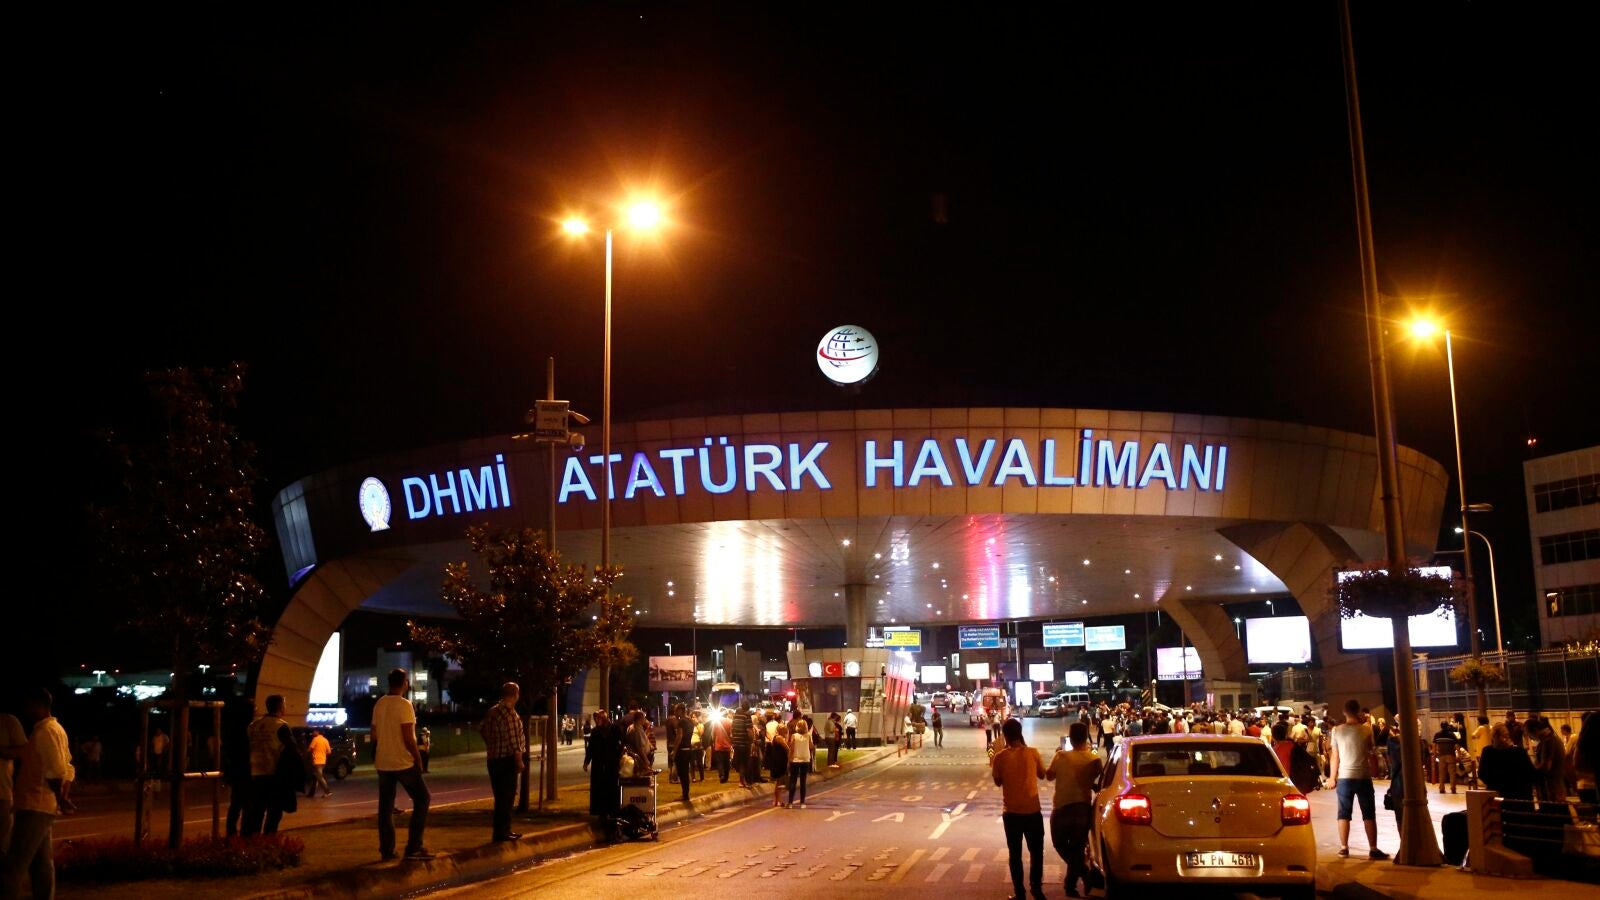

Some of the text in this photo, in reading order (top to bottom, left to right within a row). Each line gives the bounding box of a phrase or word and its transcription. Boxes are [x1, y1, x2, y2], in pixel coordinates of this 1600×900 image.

[402, 453, 511, 520] DHMİ
[558, 436, 832, 503] ATATÜRK
[865, 429, 1228, 492] HAVALİMANI
[1192, 854, 1206, 866] 34
[1210, 854, 1225, 866] PN
